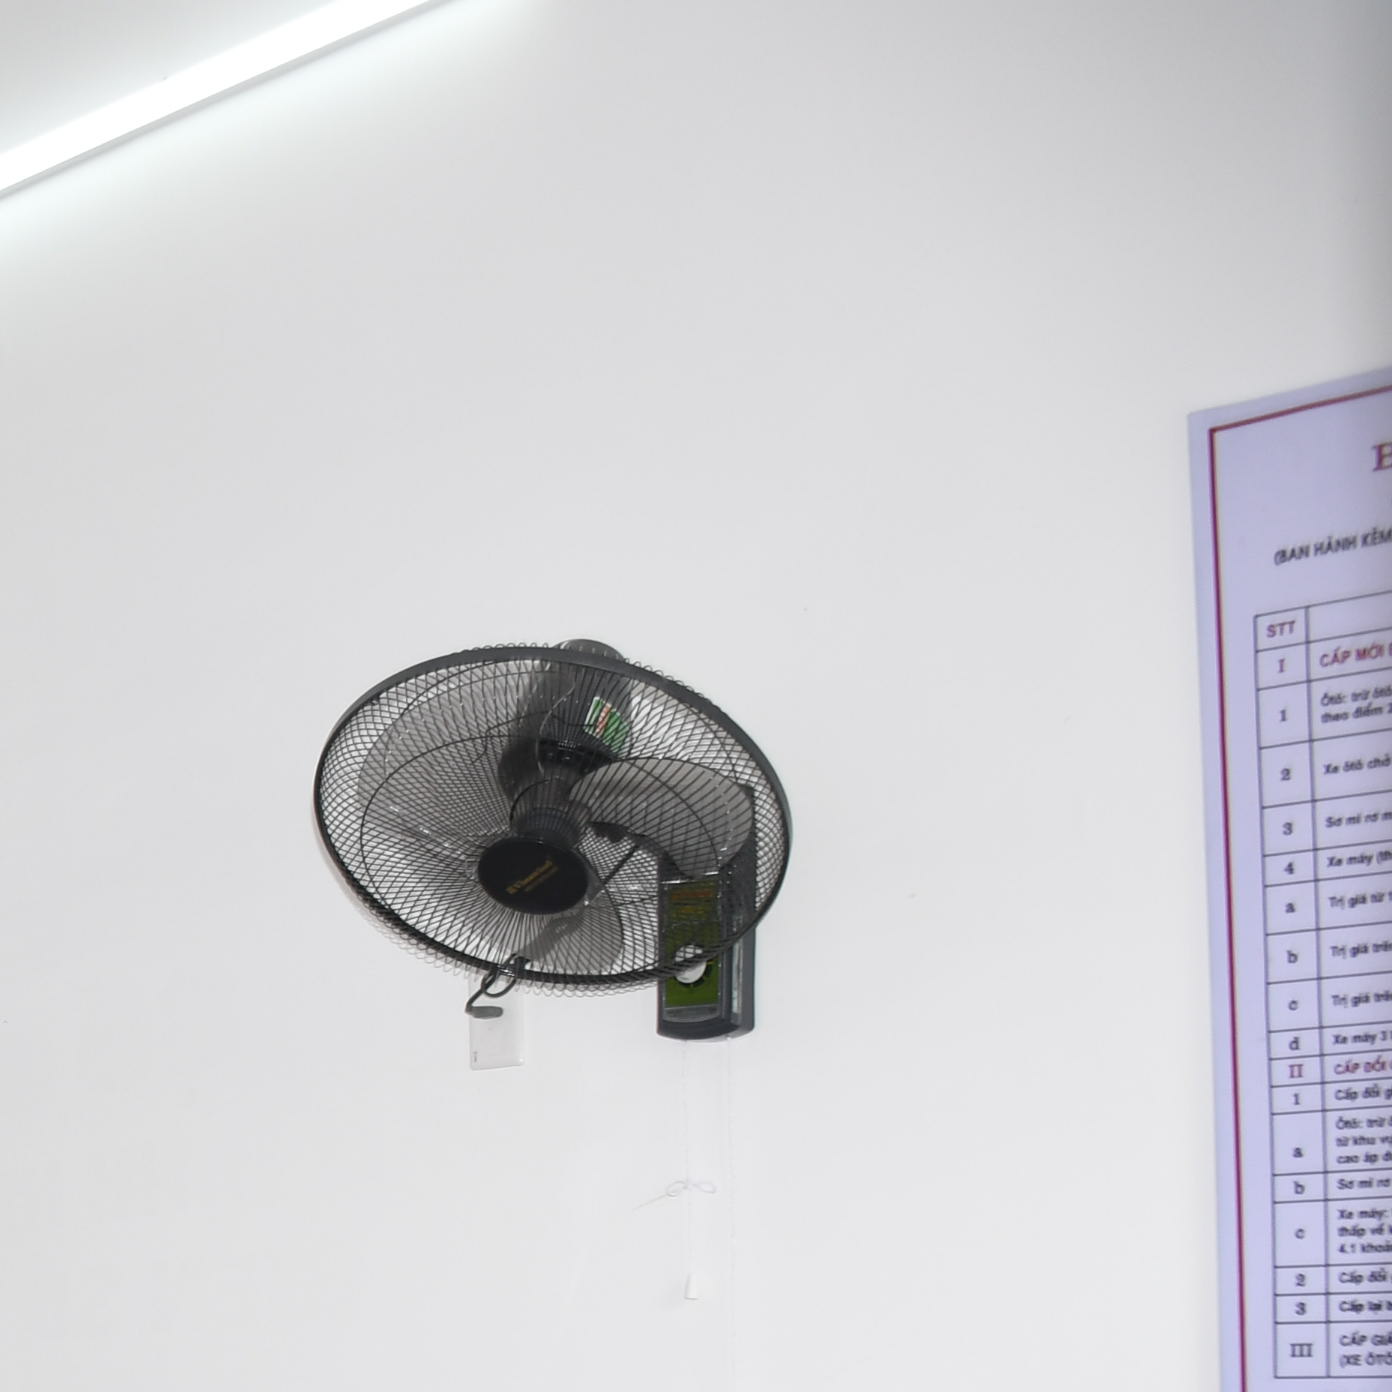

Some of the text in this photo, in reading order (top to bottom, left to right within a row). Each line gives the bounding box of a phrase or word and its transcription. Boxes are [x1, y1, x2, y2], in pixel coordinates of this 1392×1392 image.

[1266, 620, 1296, 638] STT
[1320, 646, 1351, 667] CẤP
[1280, 768, 1291, 781] 2
[1282, 822, 1293, 835] 3
[1284, 862, 1294, 874] 4
[1327, 856, 1343, 868] Xe
[1346, 852, 1373, 866] máy
[1287, 950, 1298, 964] b
[1288, 1000, 1298, 1011] c
[1289, 1037, 1300, 1051] d
[1332, 1033, 1348, 1045] Xe
[1351, 1032, 1377, 1046] máy
[1288, 1064, 1303, 1078] II
[1334, 1060, 1360, 1075] CẤP
[1294, 1181, 1305, 1195] b
[1294, 1228, 1305, 1239] c
[1295, 1273, 1306, 1287] 2
[1295, 1302, 1307, 1315] 3
[1290, 1343, 1313, 1357] III
